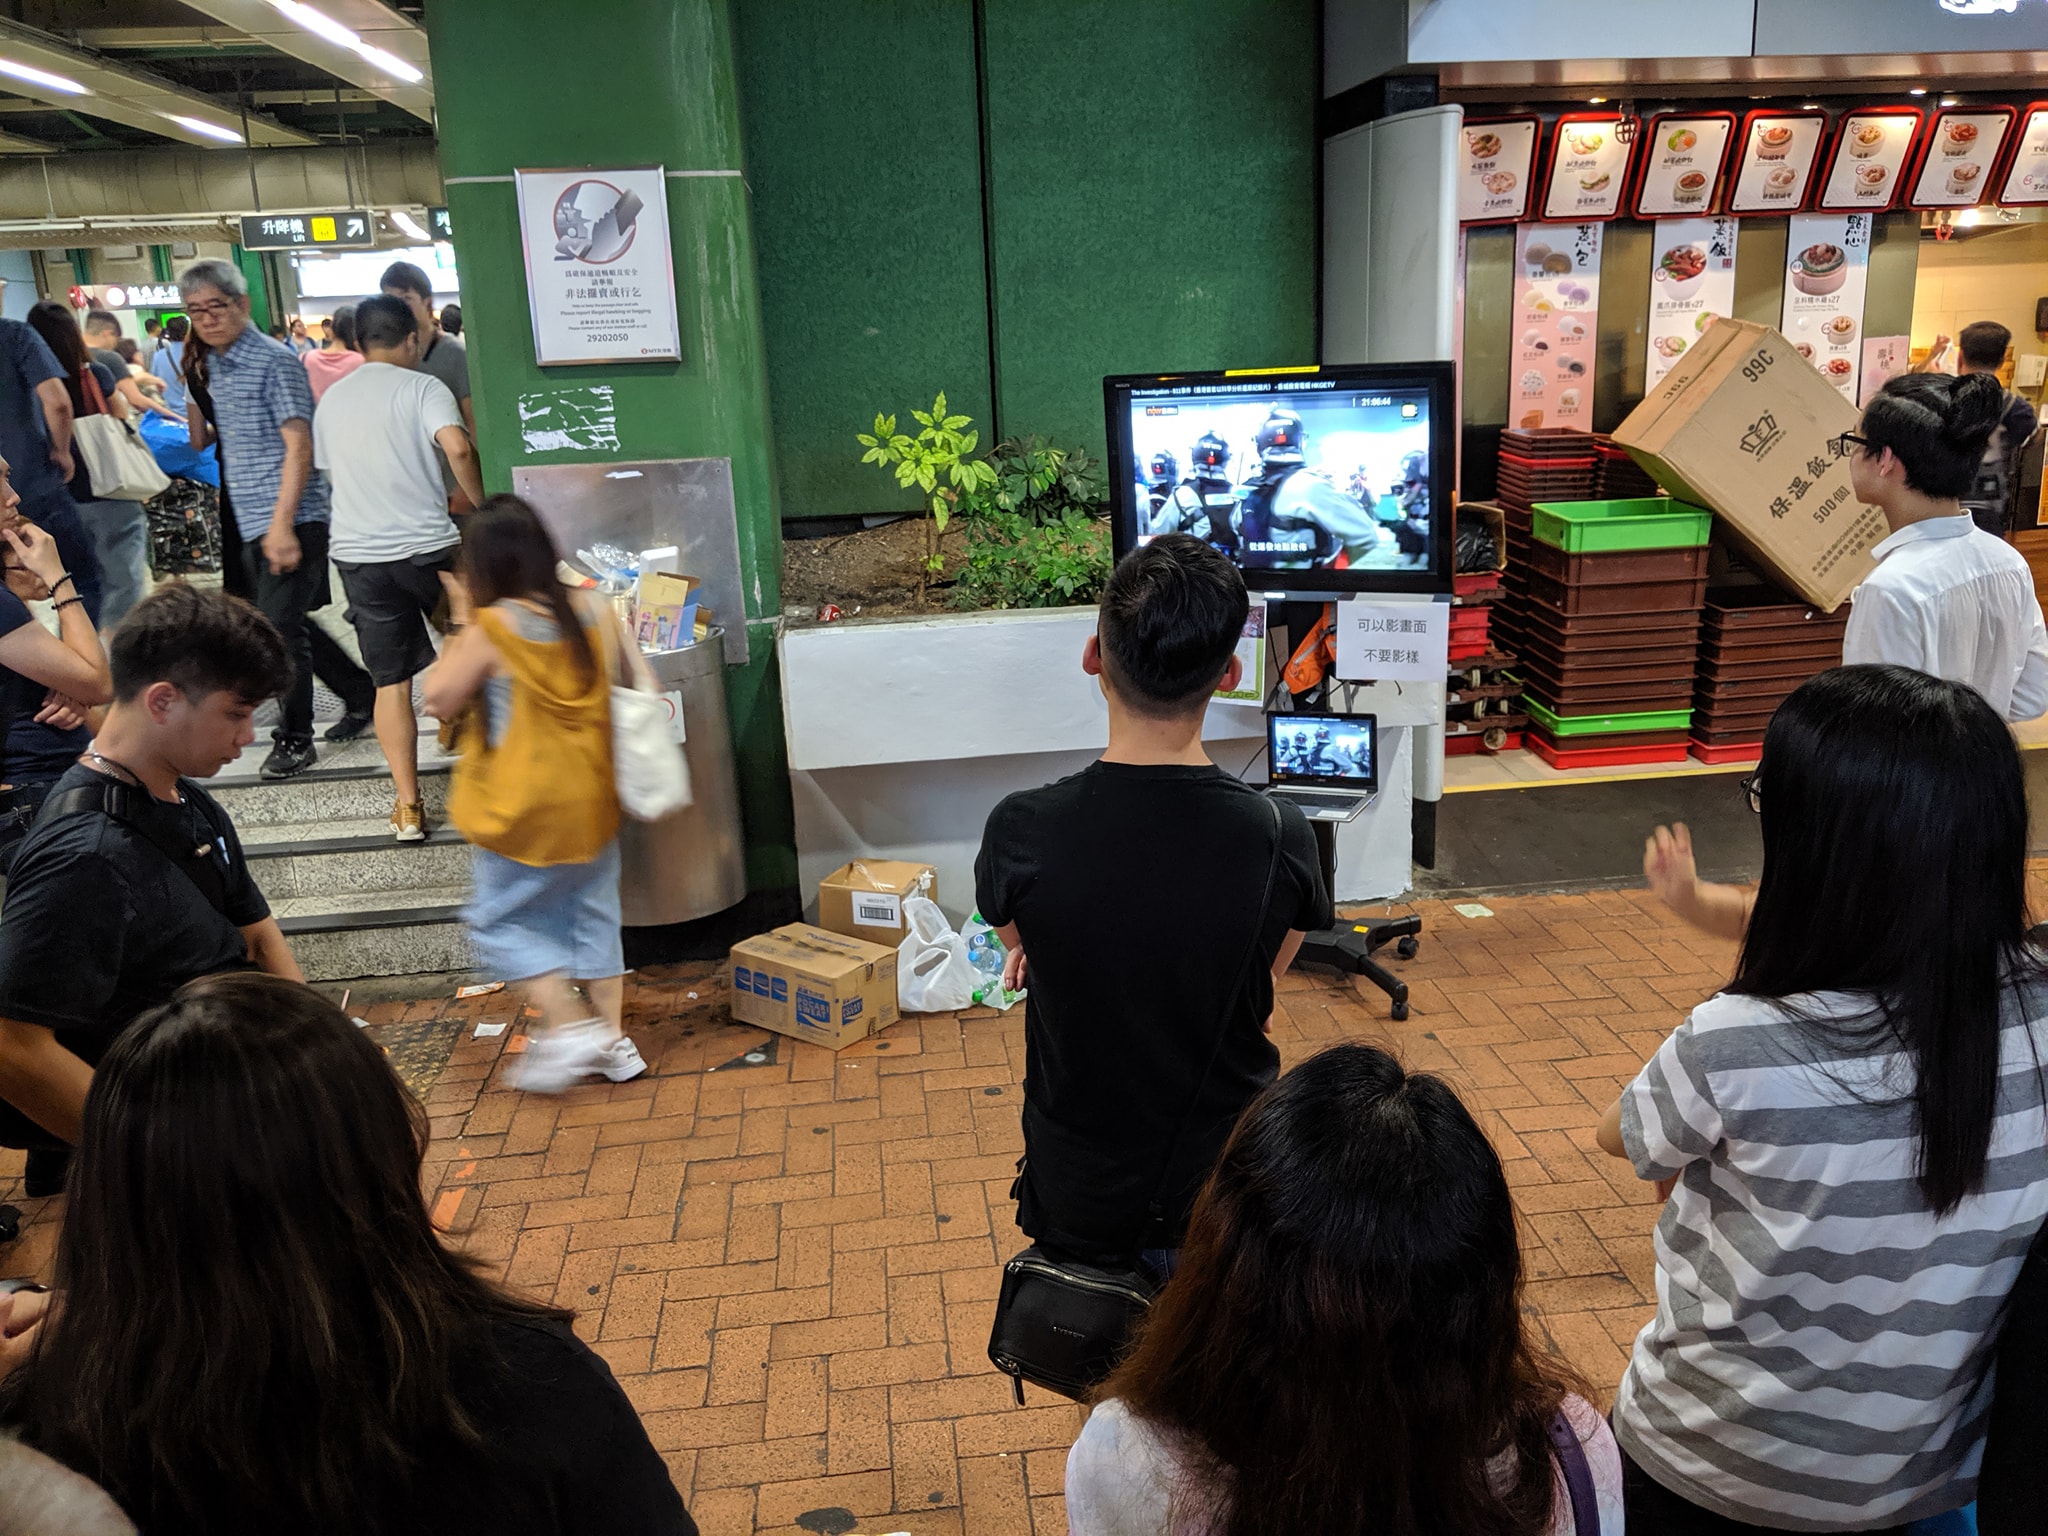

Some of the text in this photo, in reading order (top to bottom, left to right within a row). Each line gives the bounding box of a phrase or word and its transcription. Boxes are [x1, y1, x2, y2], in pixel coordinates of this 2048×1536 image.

[262, 219, 304, 235] 升降機
[1845, 215, 1863, 247] 點心
[1575, 225, 1591, 266] 蒸包
[1710, 218, 1728, 257] 蒸飯
[565, 287, 641, 299] 非法擺賣或行乞
[587, 333, 629, 342] 29202050
[1742, 348, 1775, 383] 99C
[1813, 485, 1850, 523] 500個
[1358, 618, 1427, 634] 可以影畫面
[1364, 648, 1419, 664] 不要影樣
[798, 998, 829, 1012] POCARI
[798, 1004, 826, 1018] SWEAT
